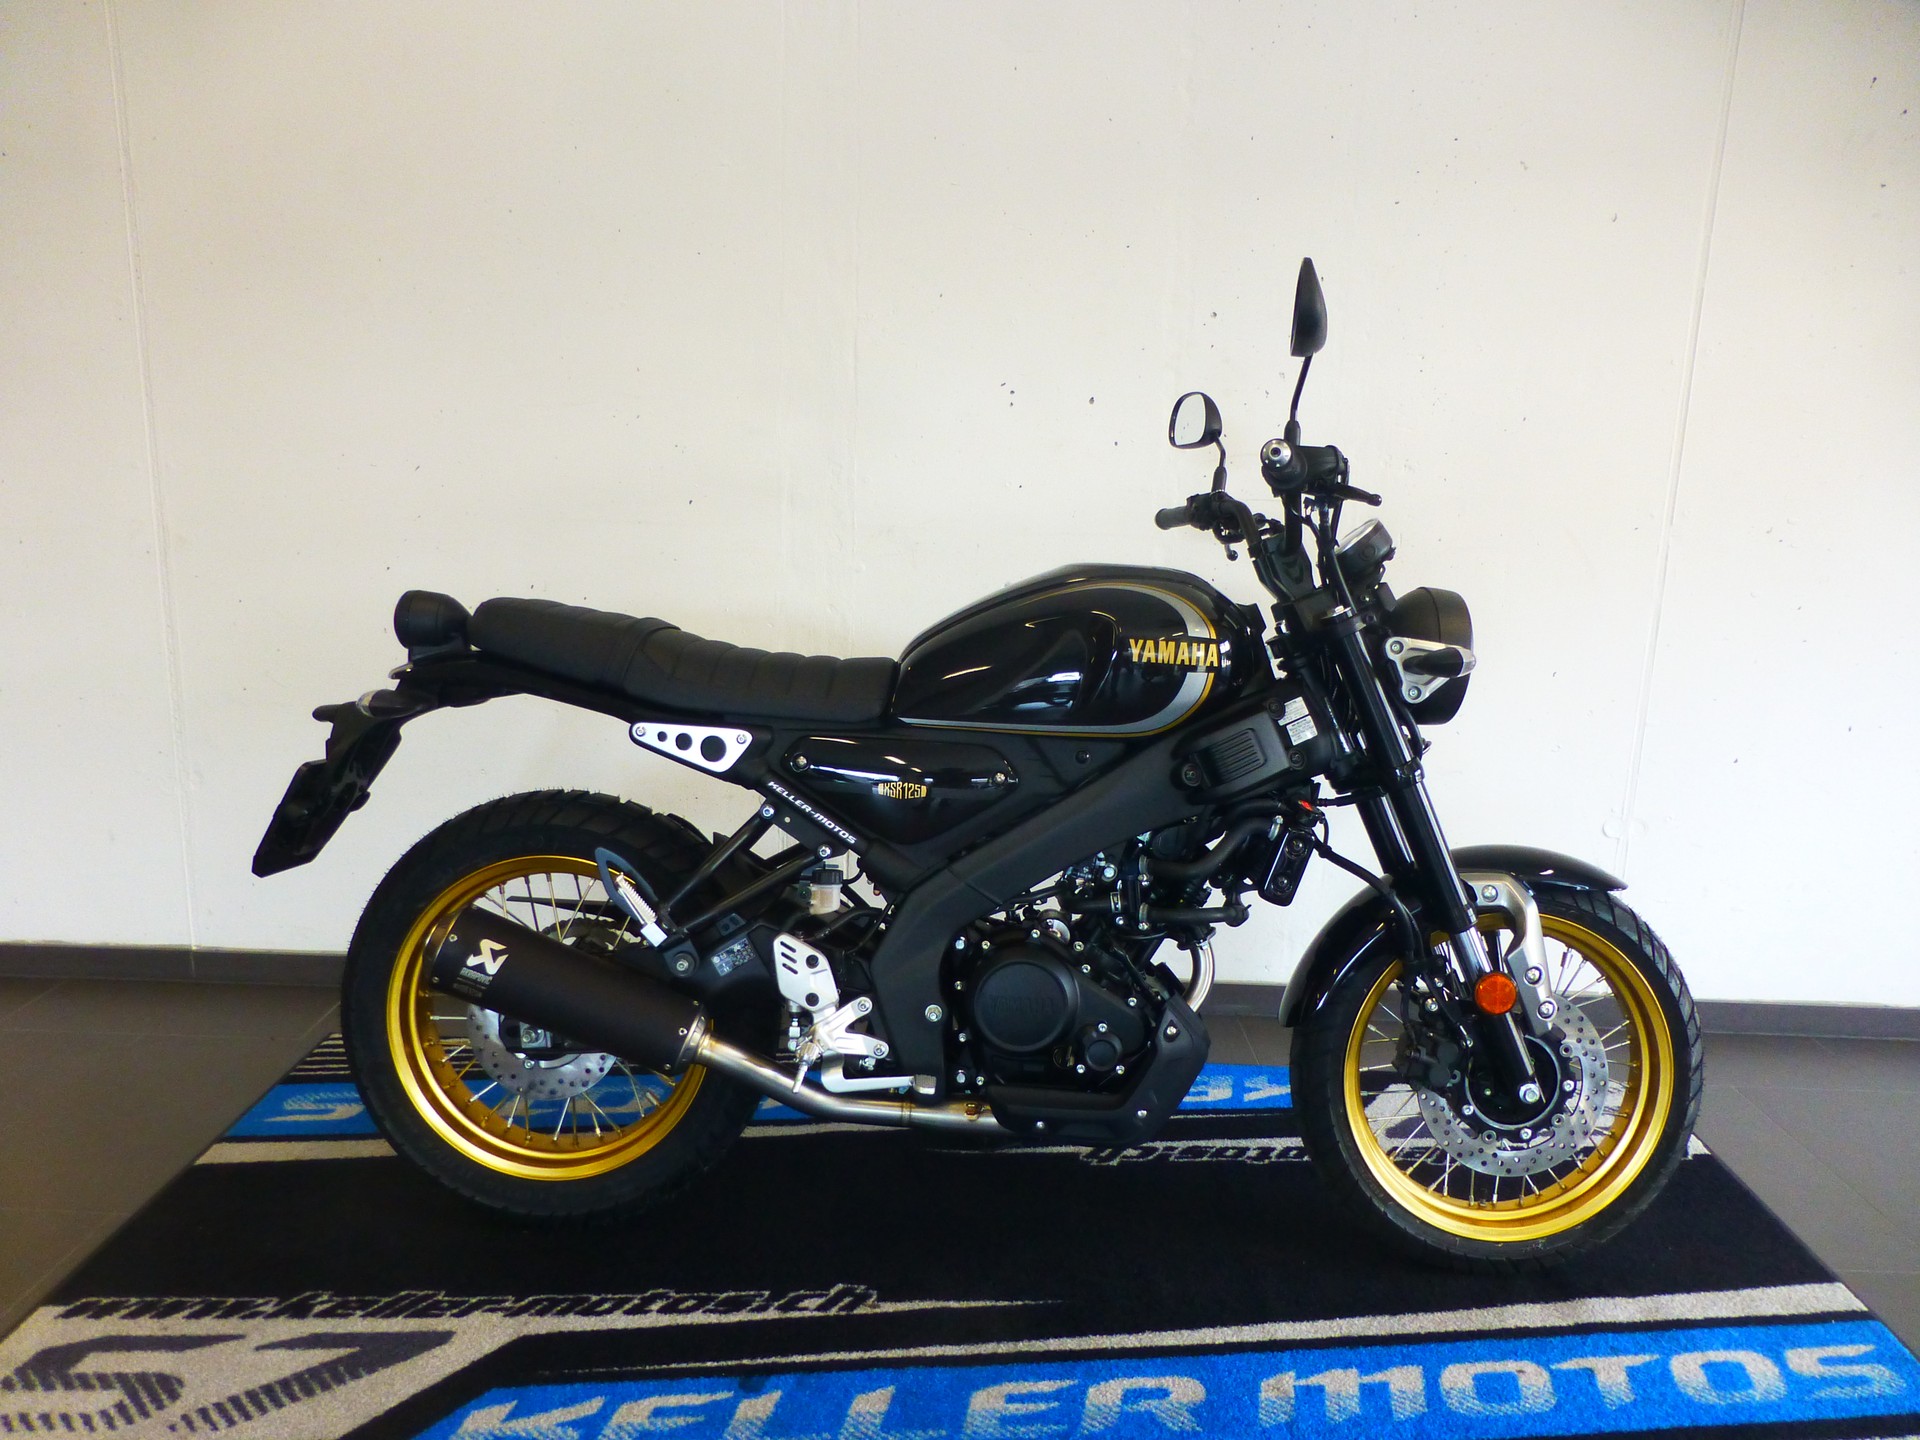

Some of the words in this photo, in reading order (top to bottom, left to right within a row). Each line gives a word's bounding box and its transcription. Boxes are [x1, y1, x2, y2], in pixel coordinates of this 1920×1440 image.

[1129, 639, 1218, 667] YAMAHA
[767, 781, 857, 844] KELLER-MOTOS
[884, 782, 921, 799] XSR125
[1259, 1345, 1907, 1429] MOTOS
